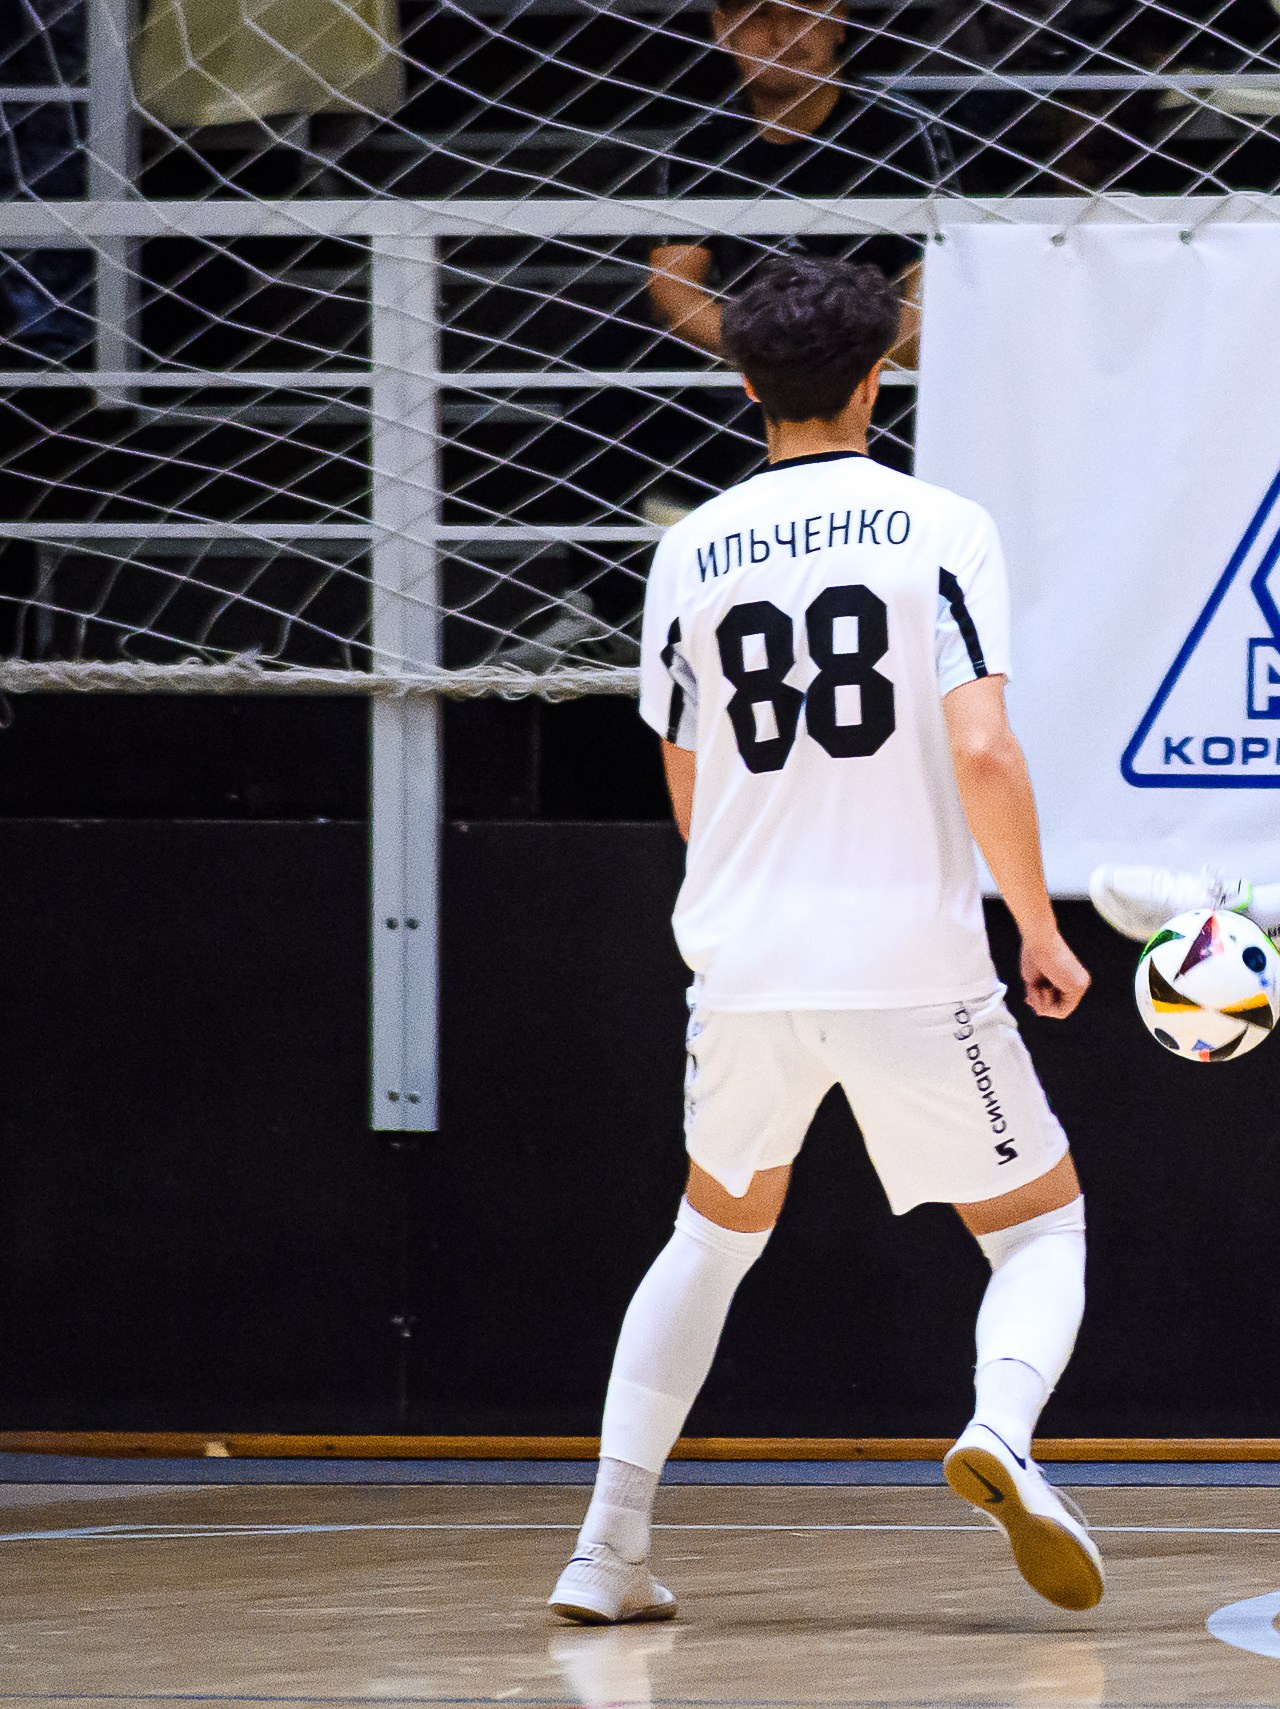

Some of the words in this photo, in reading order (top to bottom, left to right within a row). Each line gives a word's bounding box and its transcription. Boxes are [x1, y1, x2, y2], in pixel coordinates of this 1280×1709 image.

[696, 508, 912, 584] ИЛЬЧЕНКО
[714, 583, 897, 775] 88
[953, 1007, 975, 1042] ба
[965, 1043, 1008, 1135] синара
